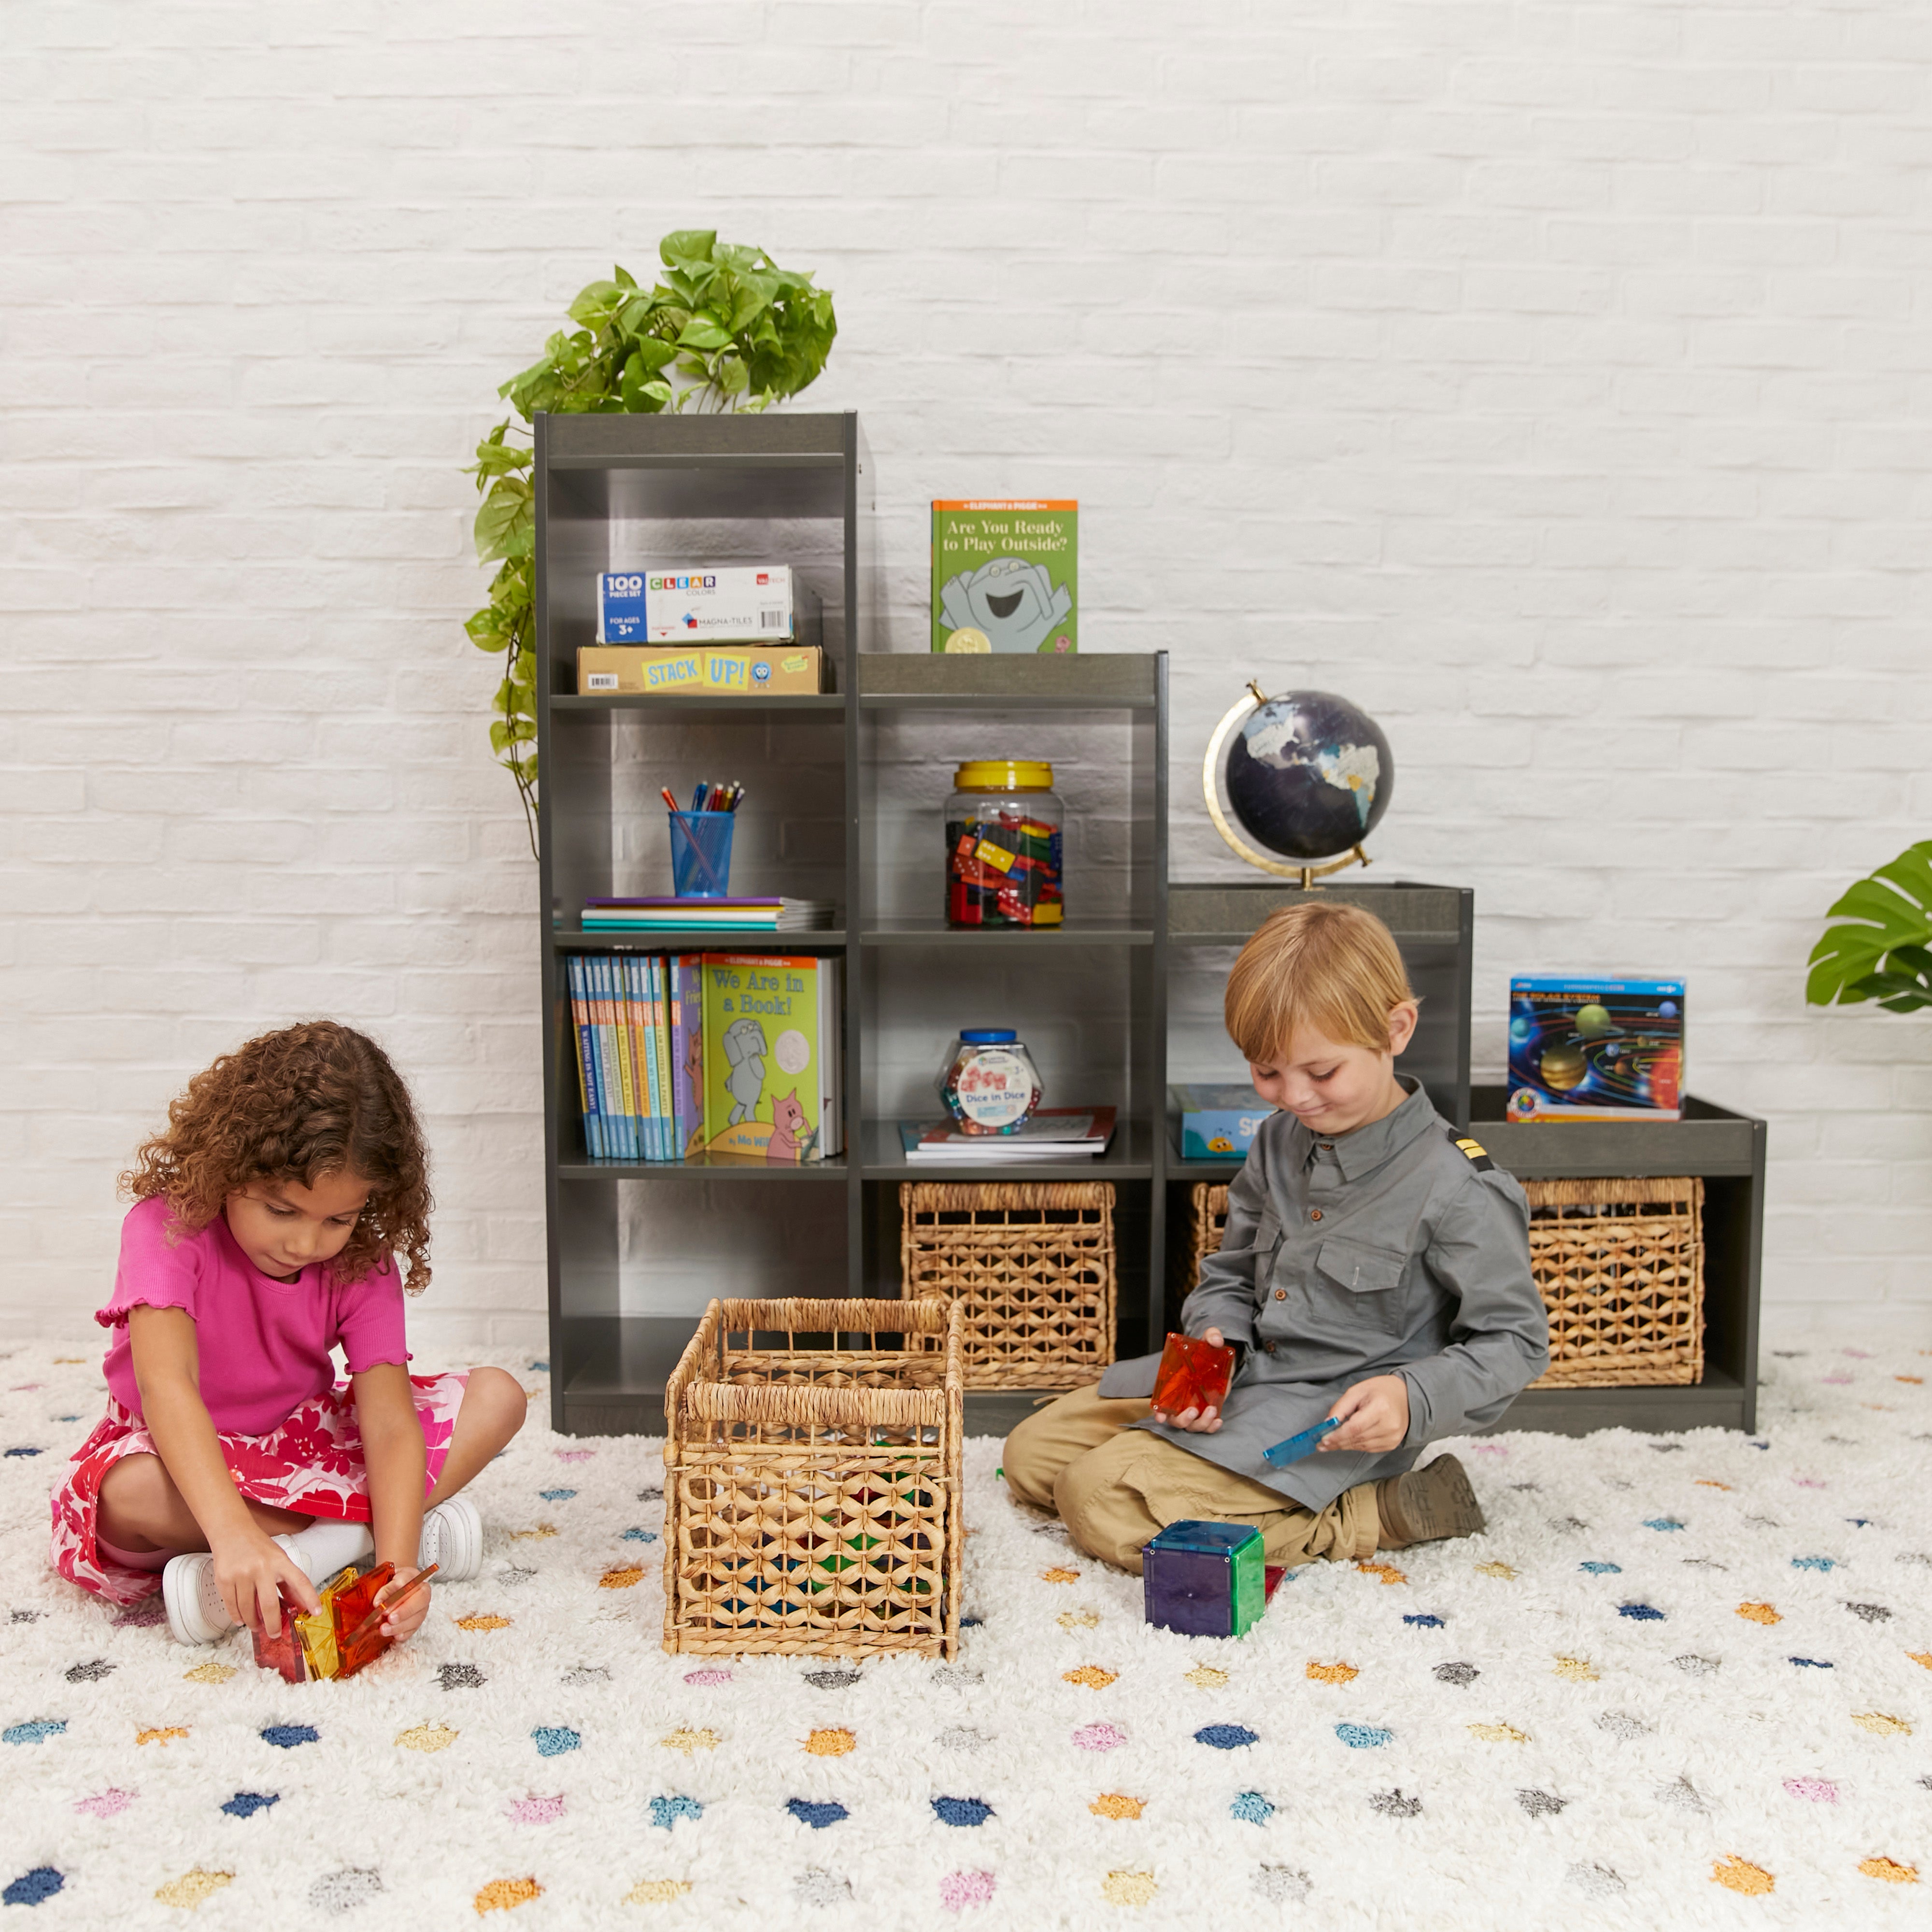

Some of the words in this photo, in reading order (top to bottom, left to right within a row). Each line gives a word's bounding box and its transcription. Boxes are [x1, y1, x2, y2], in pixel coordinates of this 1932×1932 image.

[948, 520, 976, 534] Are
[981, 520, 1009, 534] You
[1015, 520, 1064, 537] Ready
[943, 538, 959, 551] to
[964, 537, 996, 554] Play
[1001, 537, 1067, 551] Outside?
[607, 576, 642, 591] 100
[651, 576, 715, 589] CLEAR
[699, 617, 753, 625] MAGNA-TILES
[619, 624, 633, 635] 3+
[648, 659, 698, 685] STACK
[710, 658, 745, 684] UP!
[712, 969, 740, 988] We
[747, 971, 779, 991] Are
[786, 973, 804, 993] in
[723, 998, 734, 1012] a
[740, 994, 792, 1015] Book!
[582, 1031, 591, 1062] WAITING
[966, 1094, 988, 1103] Dice
[738, 1135, 751, 1145] Mo
